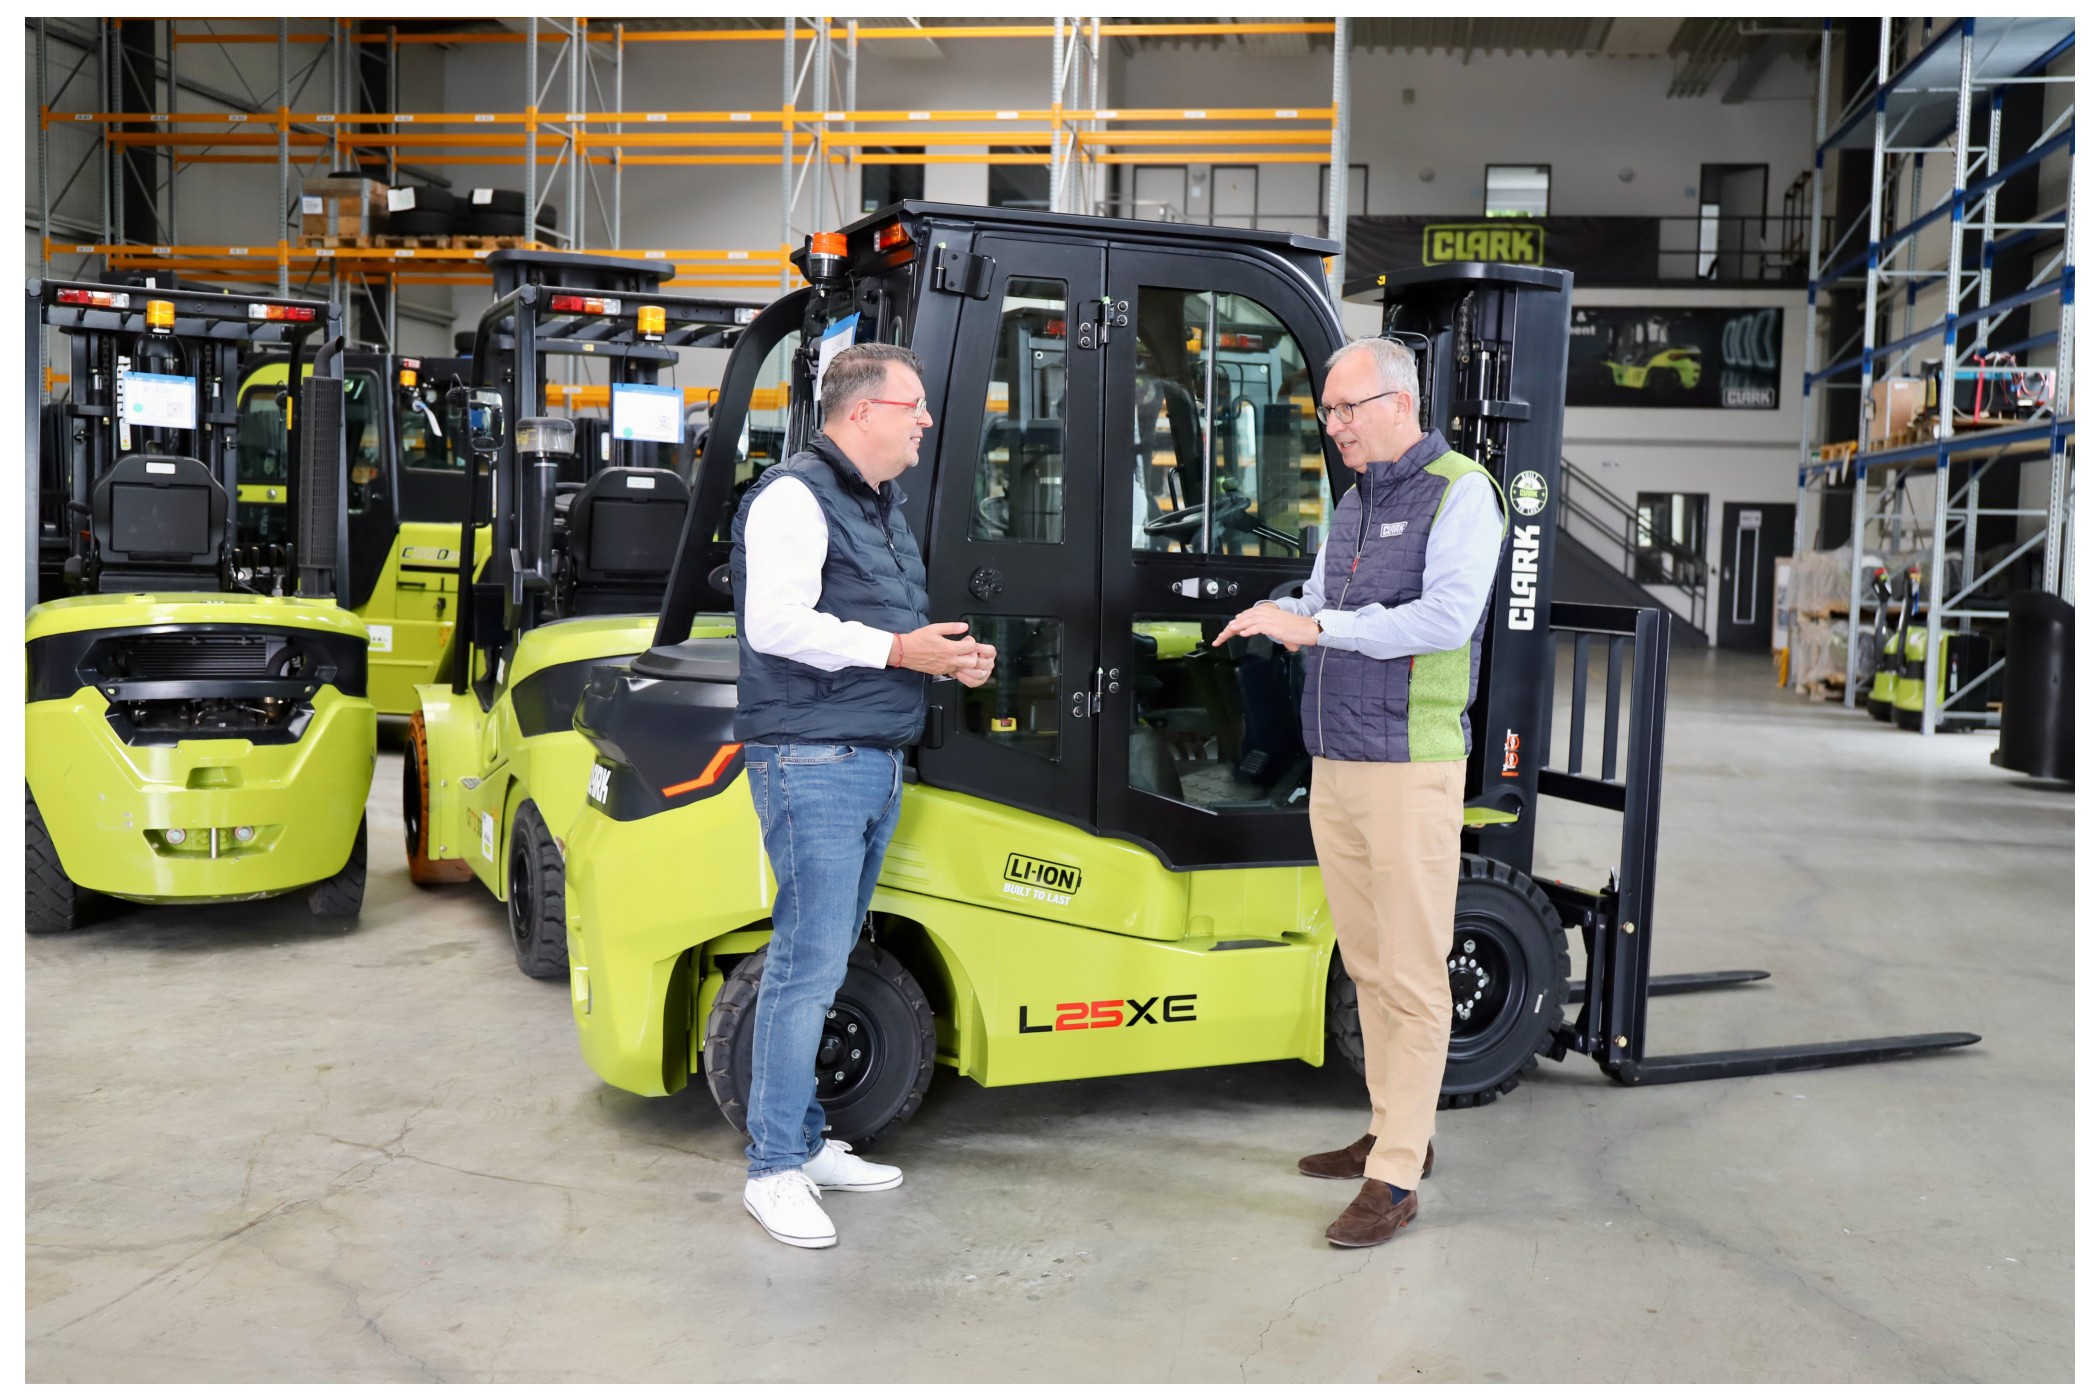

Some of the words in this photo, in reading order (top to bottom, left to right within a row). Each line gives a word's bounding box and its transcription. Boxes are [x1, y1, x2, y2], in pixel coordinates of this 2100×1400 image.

[1433, 230, 1534, 261] CLARK
[1727, 390, 1770, 405] CLARK
[1508, 525, 1540, 630] CLARK
[1010, 858, 1075, 889] LI-ION
[1003, 883, 1032, 897] BUILT
[1033, 889, 1045, 900] TO
[1047, 893, 1071, 906] LAST
[1019, 994, 1197, 1034] L25XE
